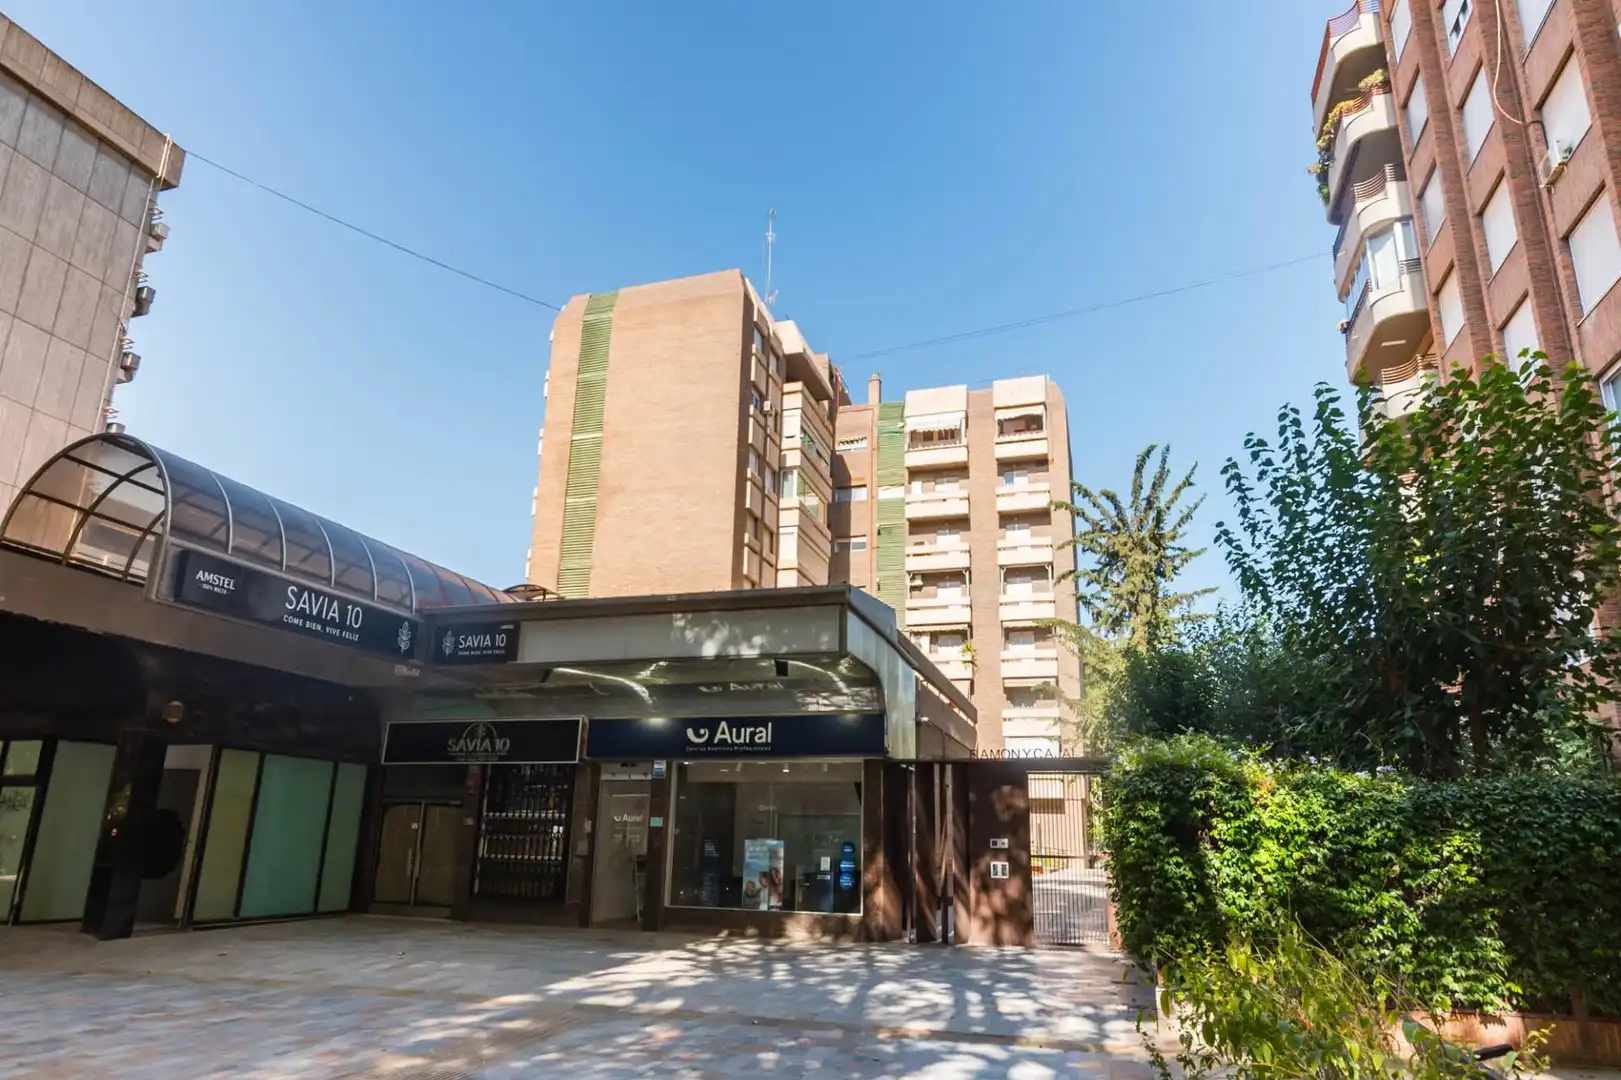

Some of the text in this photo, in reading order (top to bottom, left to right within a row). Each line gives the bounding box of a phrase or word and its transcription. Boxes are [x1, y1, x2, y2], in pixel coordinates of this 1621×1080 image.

[195, 569, 236, 590] AMSTEL
[285, 586, 363, 629] SAVIA 10
[283, 614, 304, 627] COME
[325, 626, 341, 637] VIVE
[458, 633, 506, 649] SAVIA 10
[713, 720, 772, 744] Aural
[446, 737, 492, 752] SAVIA
